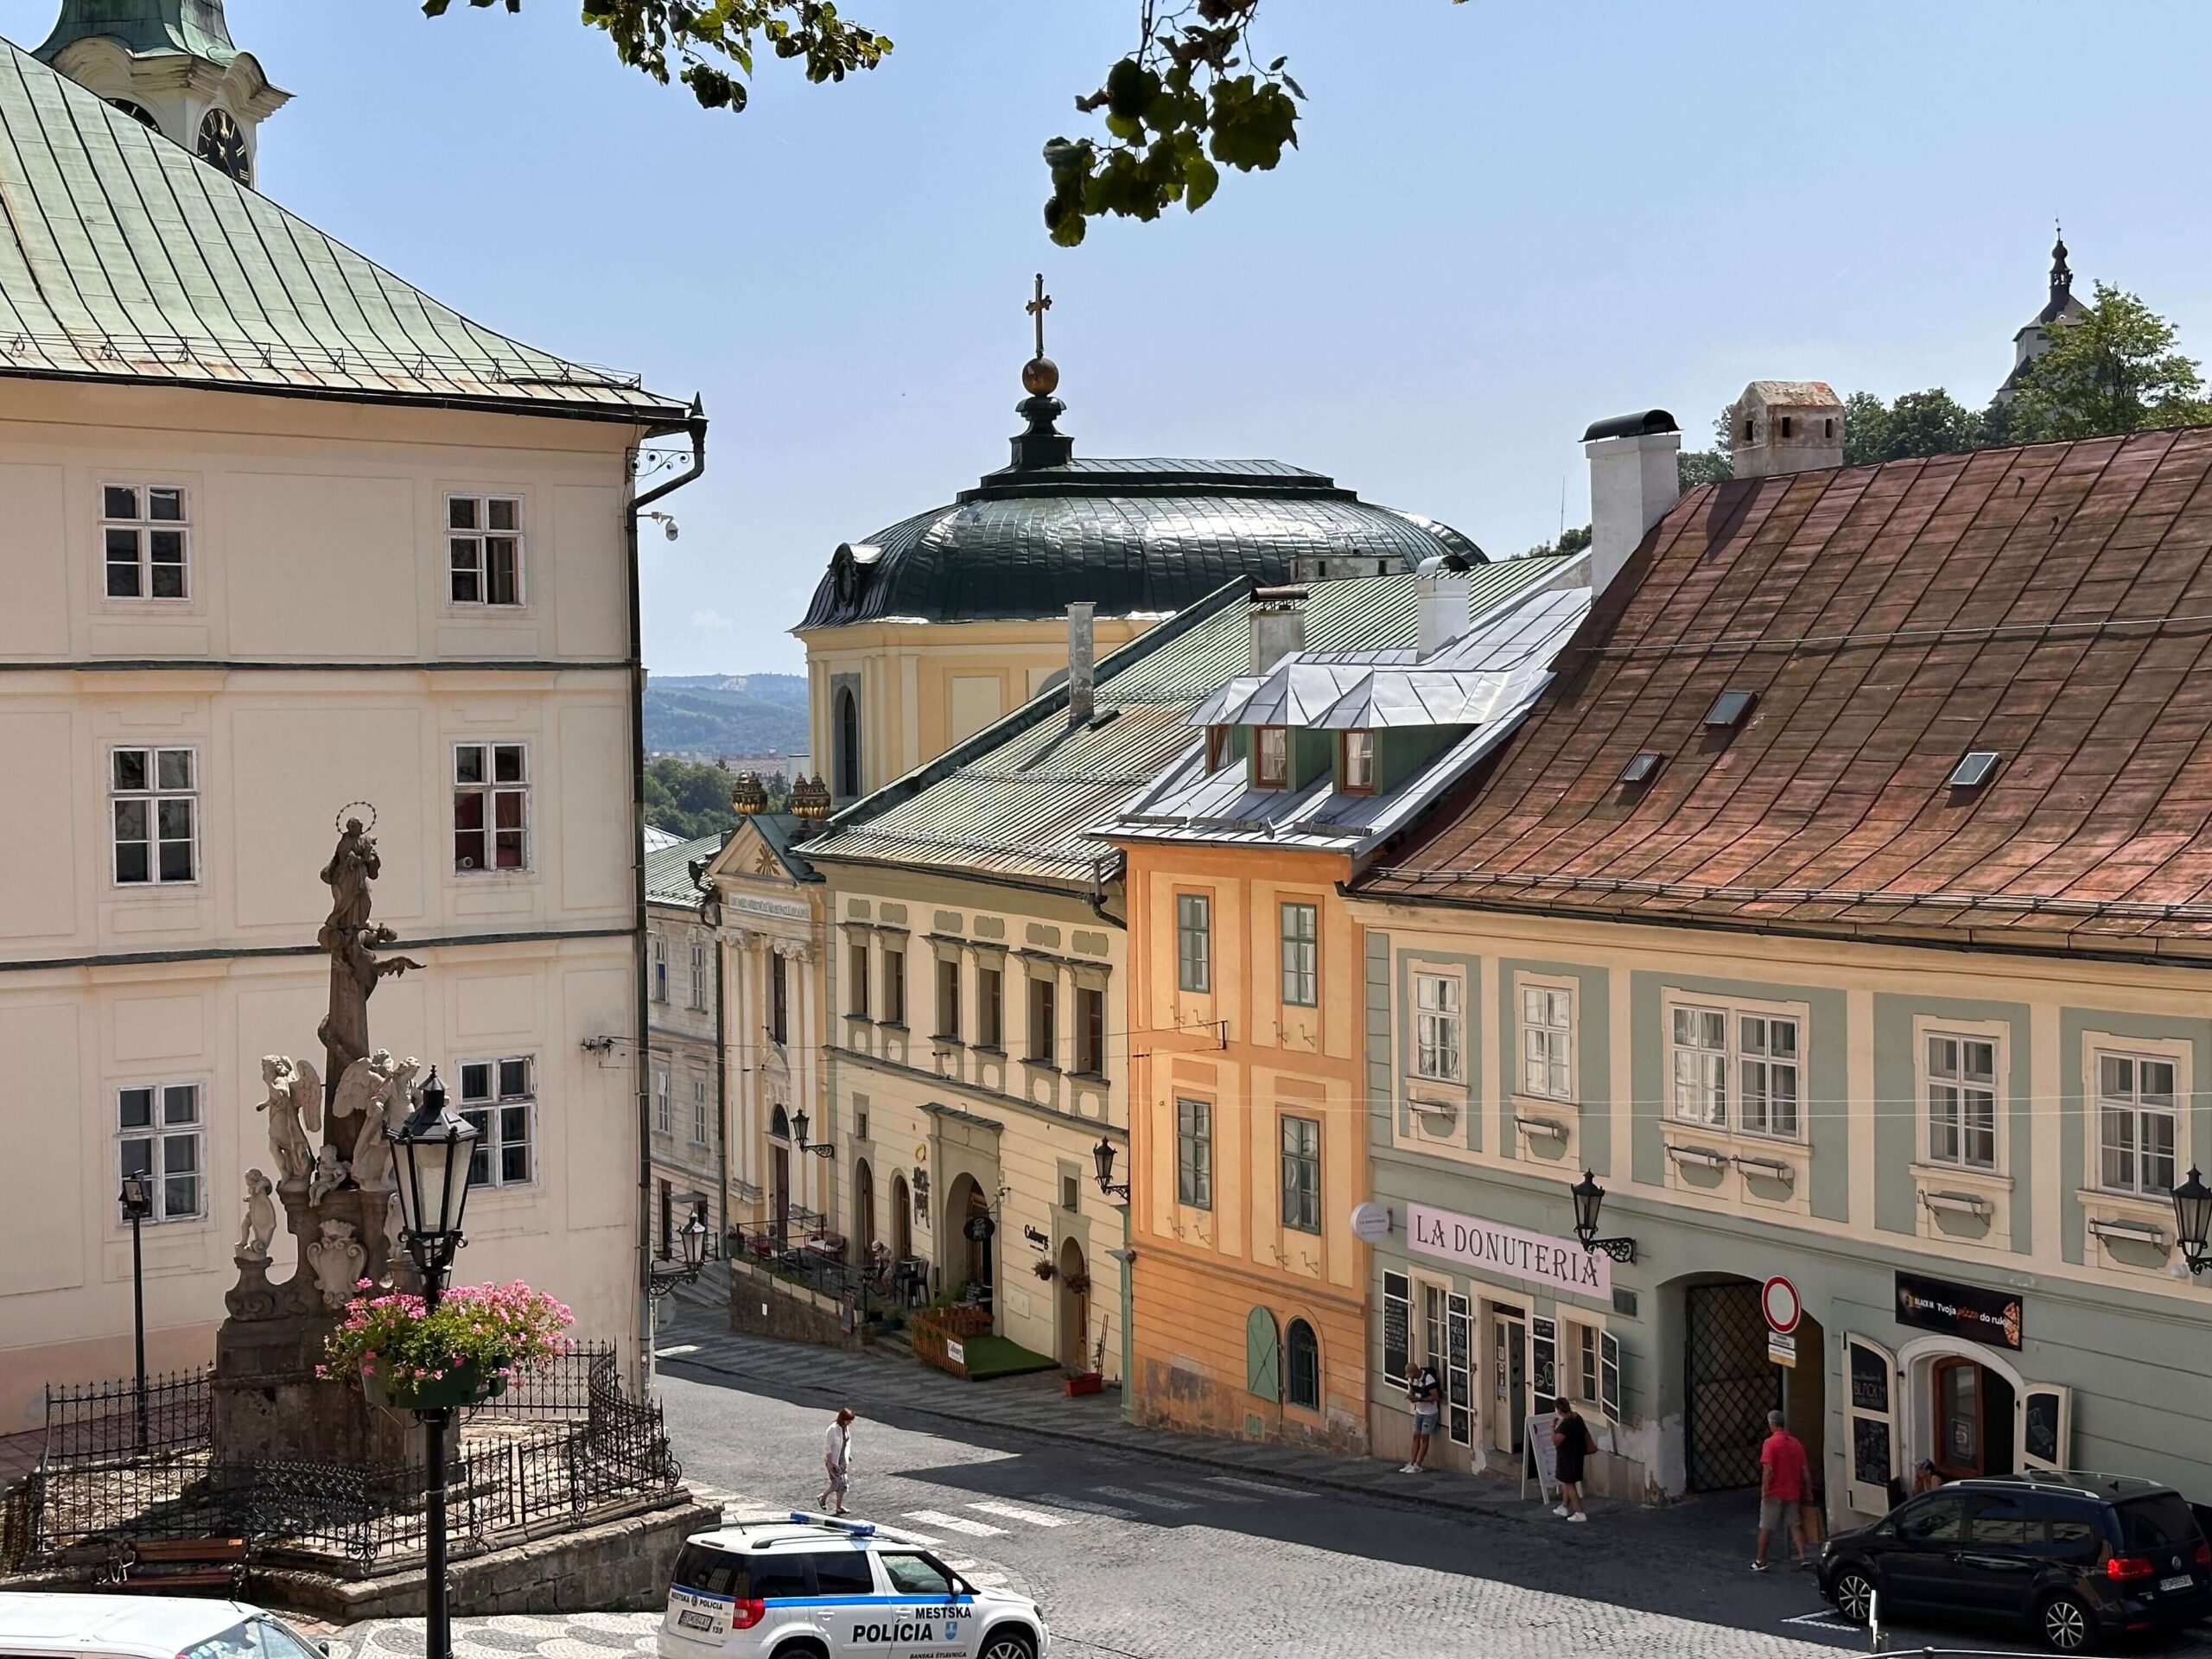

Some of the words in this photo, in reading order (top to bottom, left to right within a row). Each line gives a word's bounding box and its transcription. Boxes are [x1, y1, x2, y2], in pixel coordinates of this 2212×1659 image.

[1416, 1215, 1446, 1248] LA
[1454, 1224, 1599, 1287] DONUTERIA
[1936, 1302, 1957, 1316] Tvoja
[1956, 1307, 1980, 1320] pizza
[1980, 1313, 1990, 1323] do
[852, 1618, 933, 1643] POLÍCIA
